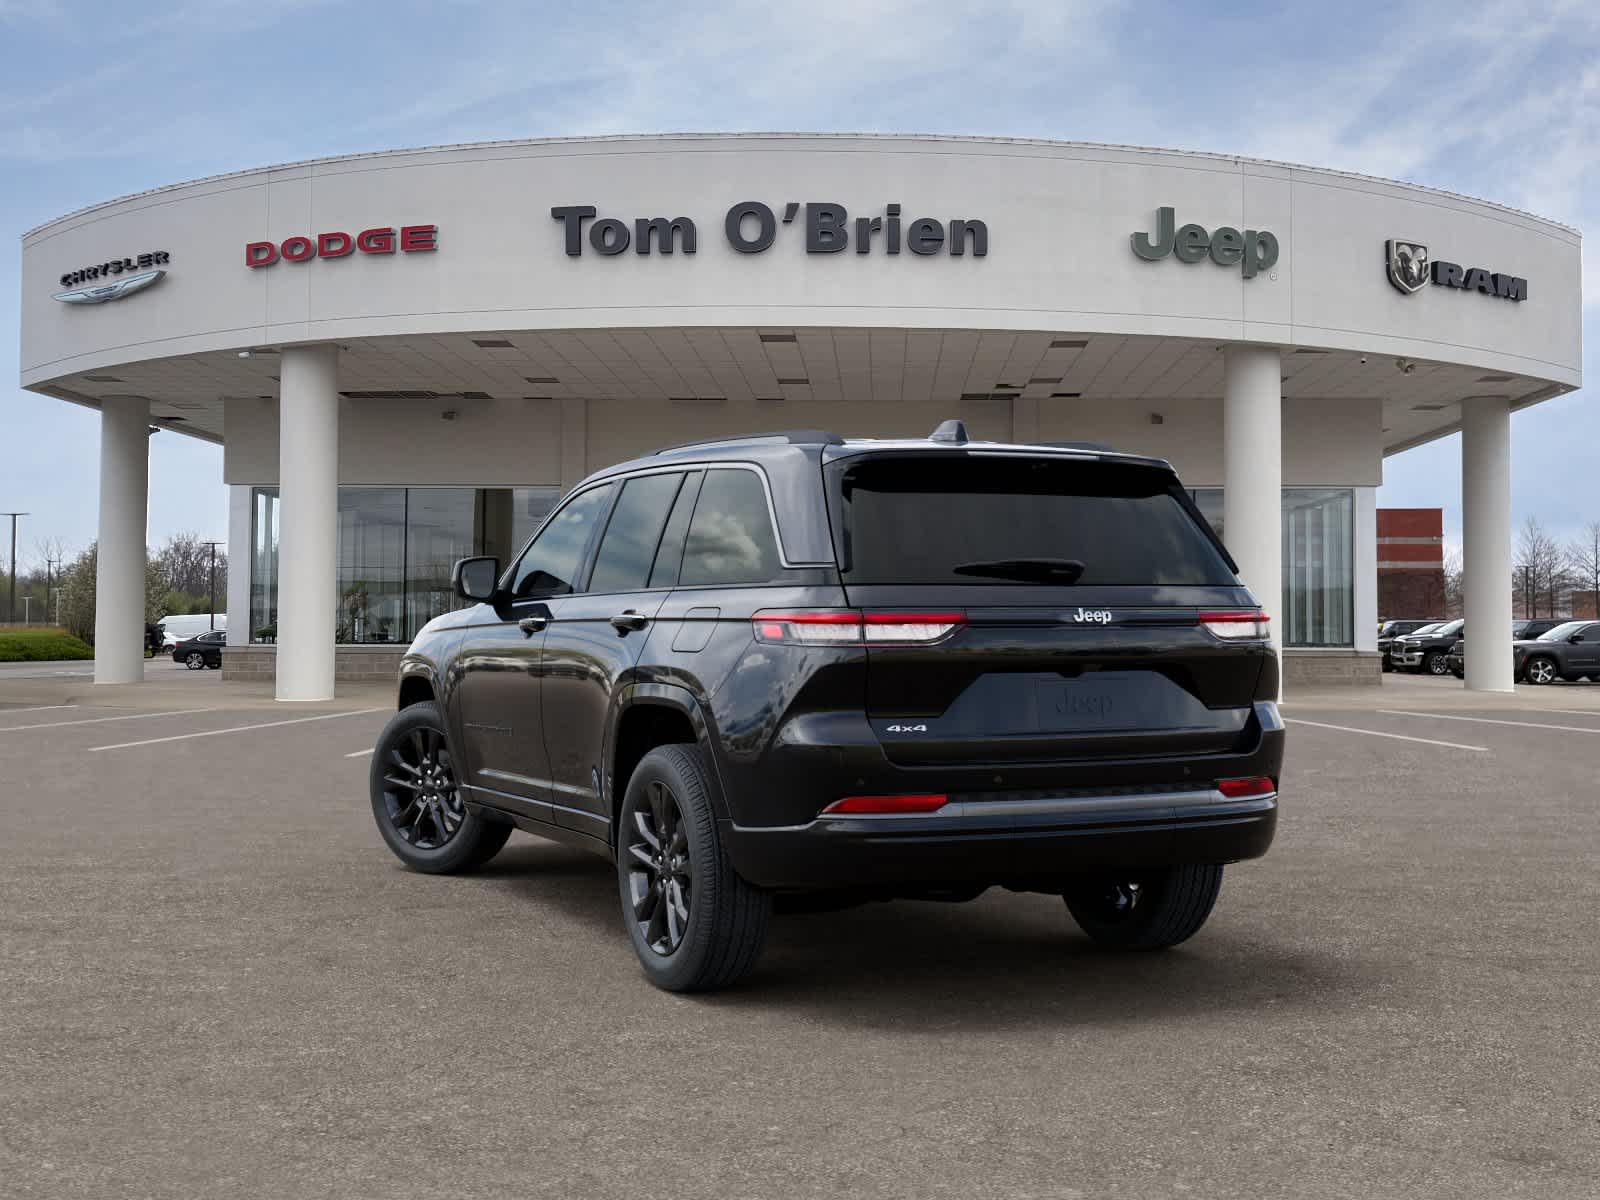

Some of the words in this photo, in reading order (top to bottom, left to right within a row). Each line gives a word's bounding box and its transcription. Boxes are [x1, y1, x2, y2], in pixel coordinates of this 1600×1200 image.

[245, 224, 438, 269] DODGE
[551, 205, 697, 257] Tom
[725, 201, 988, 257] O'Brien
[1130, 206, 1279, 280] Jeep
[60, 250, 170, 287] CHRYSLER
[1430, 260, 1528, 302] RAM
[1073, 607, 1112, 625] Jeep
[886, 724, 928, 733] 4x4
